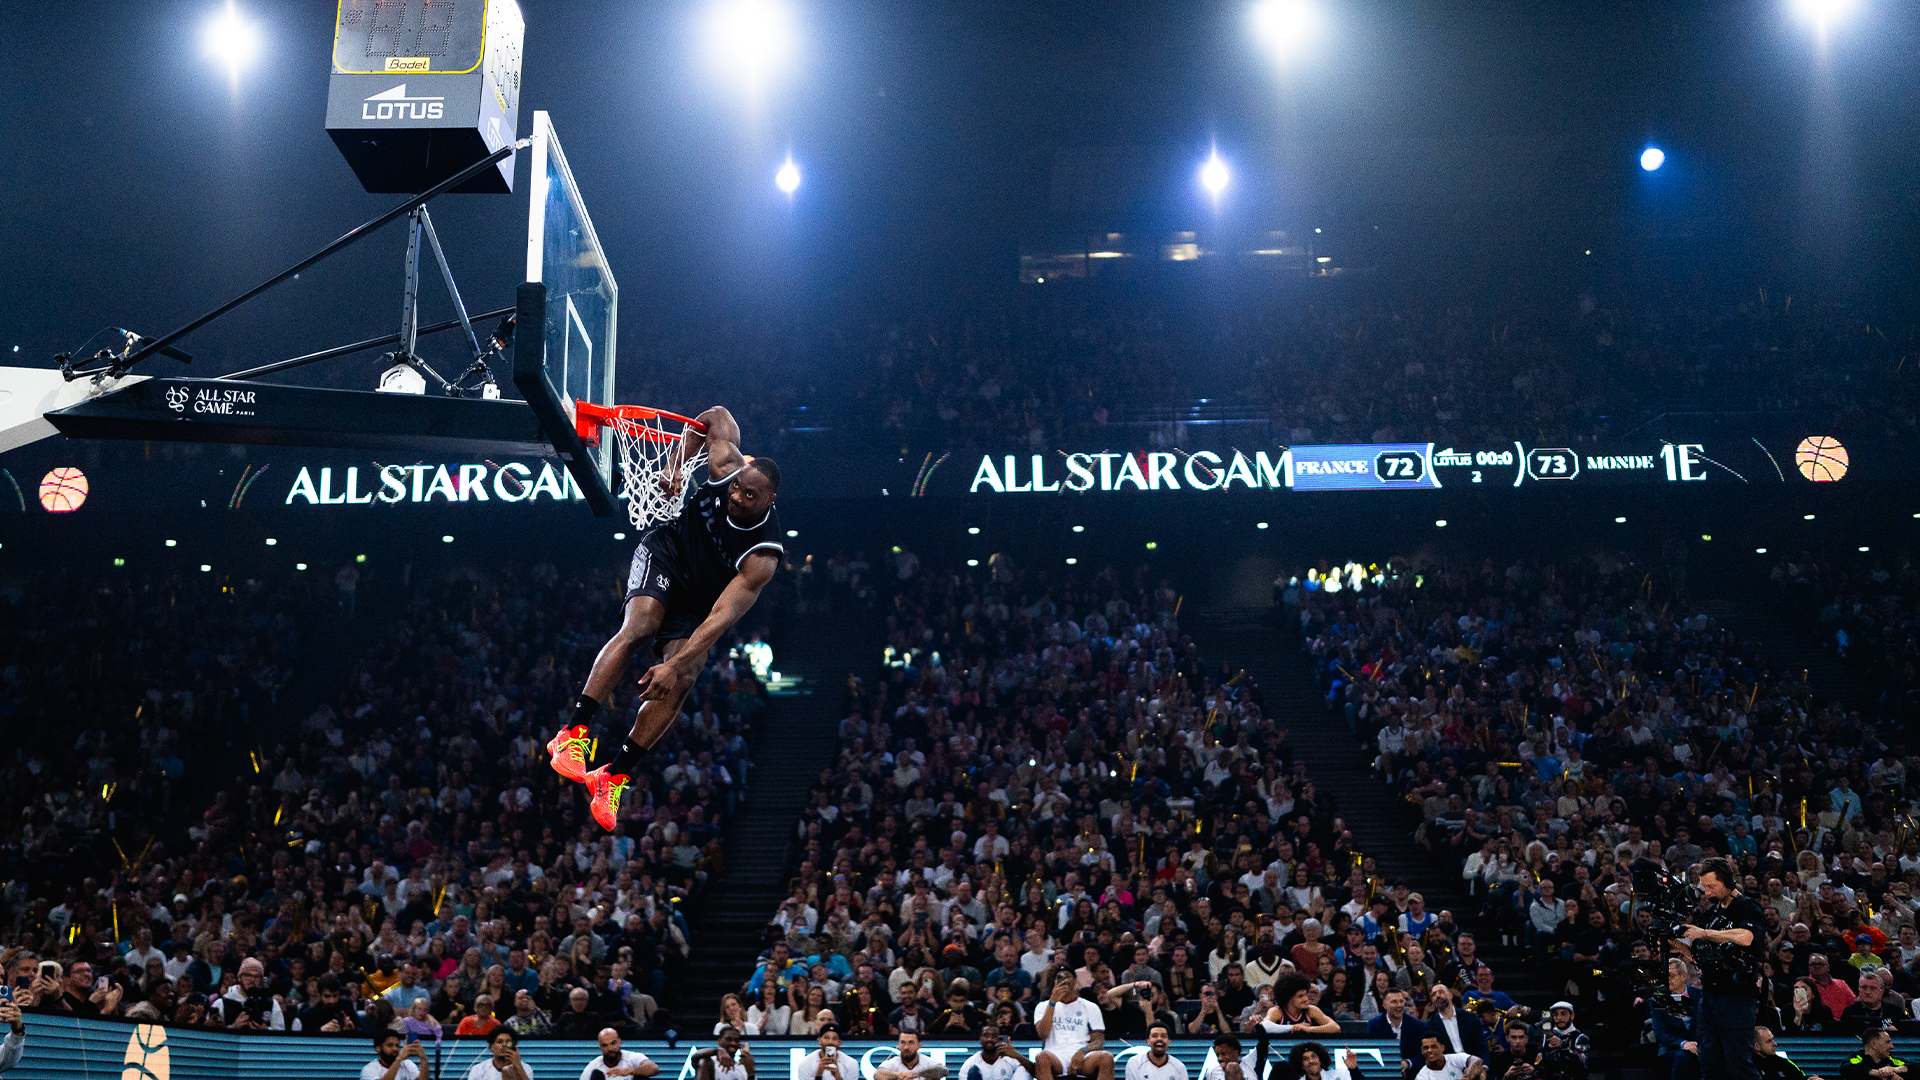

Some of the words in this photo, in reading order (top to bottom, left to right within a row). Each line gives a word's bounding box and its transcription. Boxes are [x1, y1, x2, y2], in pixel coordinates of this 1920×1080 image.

[388, 58, 428, 70] Bodet
[362, 102, 444, 120] LOTUS
[195, 388, 222, 402] ALL
[223, 389, 256, 404] STAR
[194, 400, 234, 415] GAME
[1433, 455, 1472, 466] LOTUS
[1475, 450, 1513, 466] 00:0
[1537, 455, 1567, 475] 73
[1587, 455, 1655, 470] MONDE
[970, 454, 1059, 492] ALL
[1065, 451, 1181, 491] STAR
[1184, 450, 1294, 491] GAM
[1296, 460, 1369, 475] FRANCE
[1385, 457, 1415, 476] 72
[285, 466, 372, 504] ALL
[377, 463, 490, 503] STAR
[1471, 470, 1482, 483] 2
[1065, 1016, 1083, 1026] STAR
